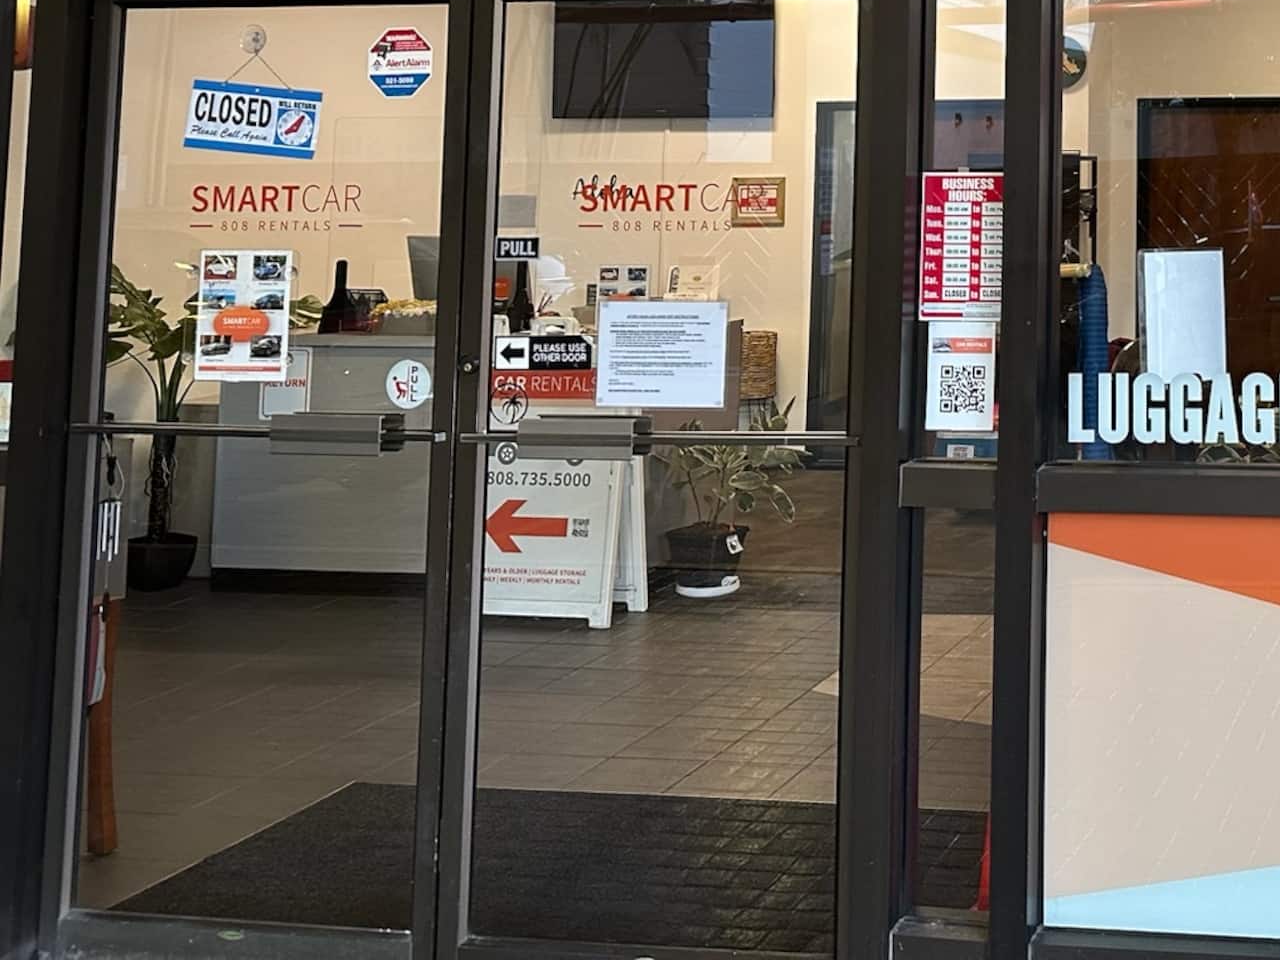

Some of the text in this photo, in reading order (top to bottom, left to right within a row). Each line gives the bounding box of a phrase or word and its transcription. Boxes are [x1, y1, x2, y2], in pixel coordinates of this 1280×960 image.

[194, 92, 272, 128] CLOSED
[293, 101, 316, 110] RETURN
[191, 124, 218, 137] Please
[219, 127, 240, 139] Call
[942, 177, 995, 191] BUSINESS
[191, 184, 362, 214] SMARTCAR
[579, 183, 764, 213] SMARTCAR
[948, 190, 988, 202] HOURS:
[220, 220, 332, 232] 808 RENTALS
[611, 219, 732, 233] 808 RENTALS
[500, 240, 537, 257] PULL
[533, 343, 587, 353] PLEASE USE
[532, 352, 588, 363] OTHER DOOR
[409, 365, 419, 403] PULL
[494, 375, 526, 392] CAR
[488, 471, 591, 487] 808.735.5000
